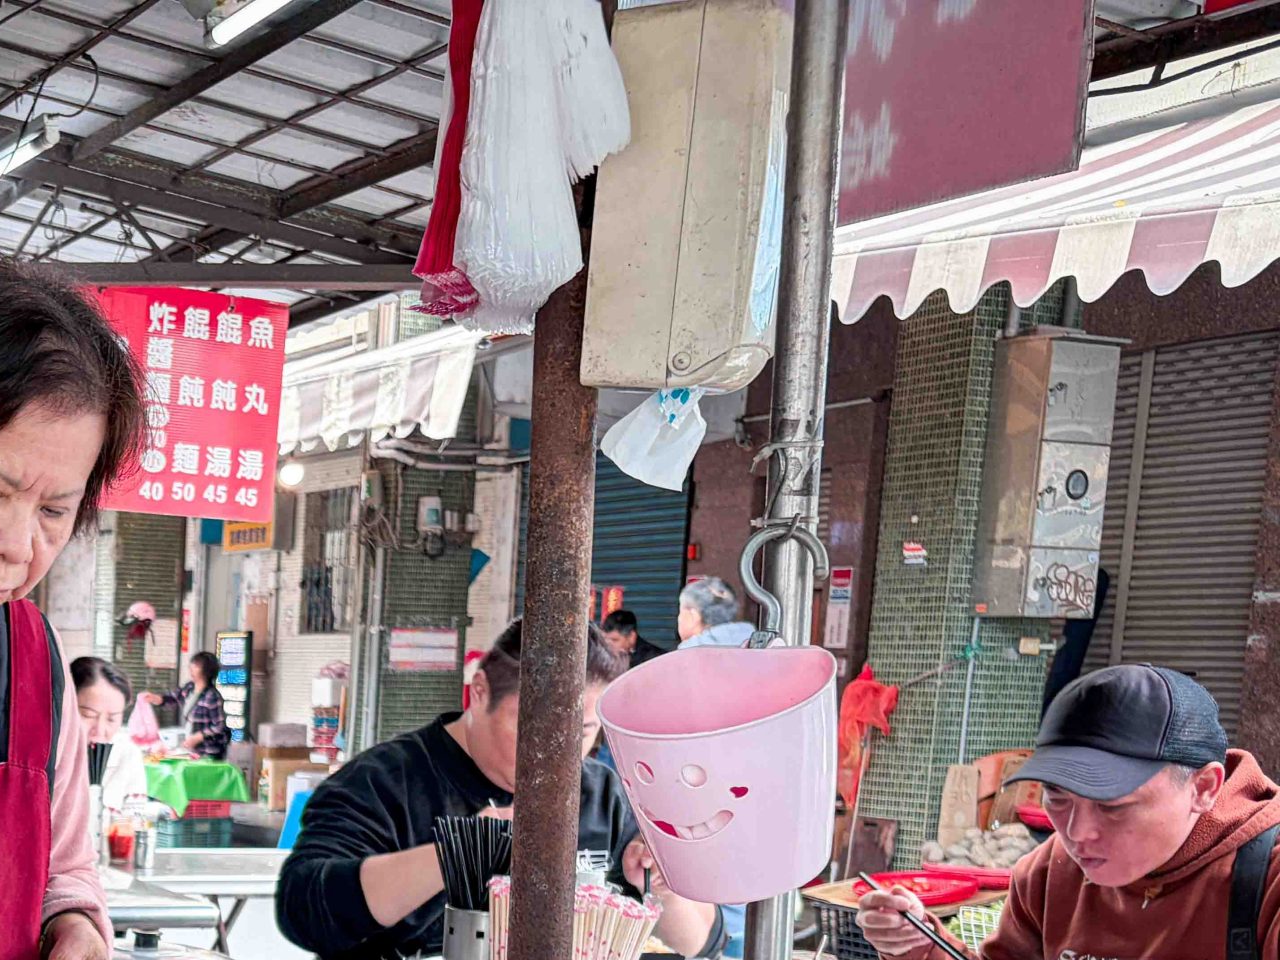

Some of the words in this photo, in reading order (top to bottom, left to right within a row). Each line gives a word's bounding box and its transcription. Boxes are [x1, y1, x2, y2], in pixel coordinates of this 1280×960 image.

[171, 306, 211, 476] 餛飩麵
[204, 311, 243, 479] 餛飩湯
[236, 316, 274, 481] 魚丸湯
[139, 481, 164, 501] 40
[171, 482, 195, 502] 50
[203, 484, 228, 504] 45
[235, 487, 258, 507] 45
